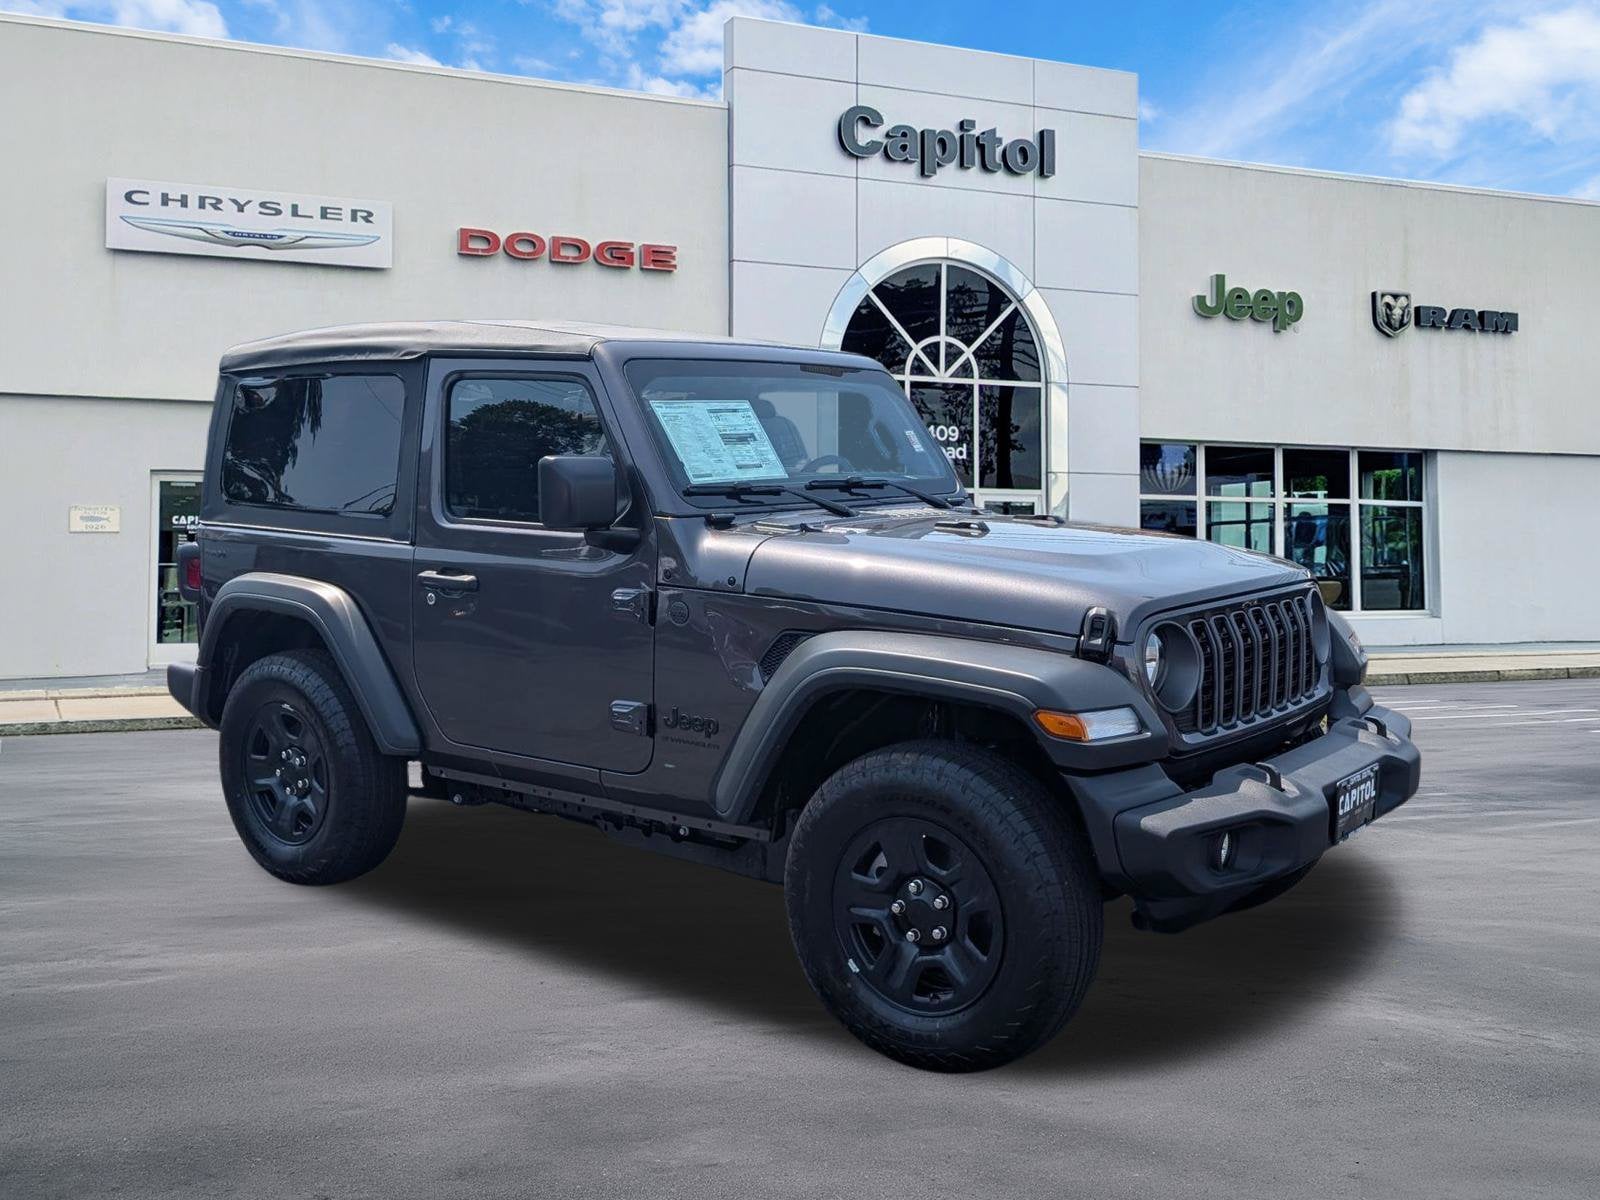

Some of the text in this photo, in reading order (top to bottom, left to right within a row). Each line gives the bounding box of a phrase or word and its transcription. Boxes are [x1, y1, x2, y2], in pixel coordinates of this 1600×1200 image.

[838, 105, 1055, 178] Capitol
[123, 189, 375, 224] CHRYSLER
[457, 227, 677, 272] DODGE
[1192, 273, 1304, 333] Jeep
[1414, 305, 1519, 334] RAM
[663, 706, 720, 739] Jeep
[1338, 778, 1376, 816] CAPITOL
